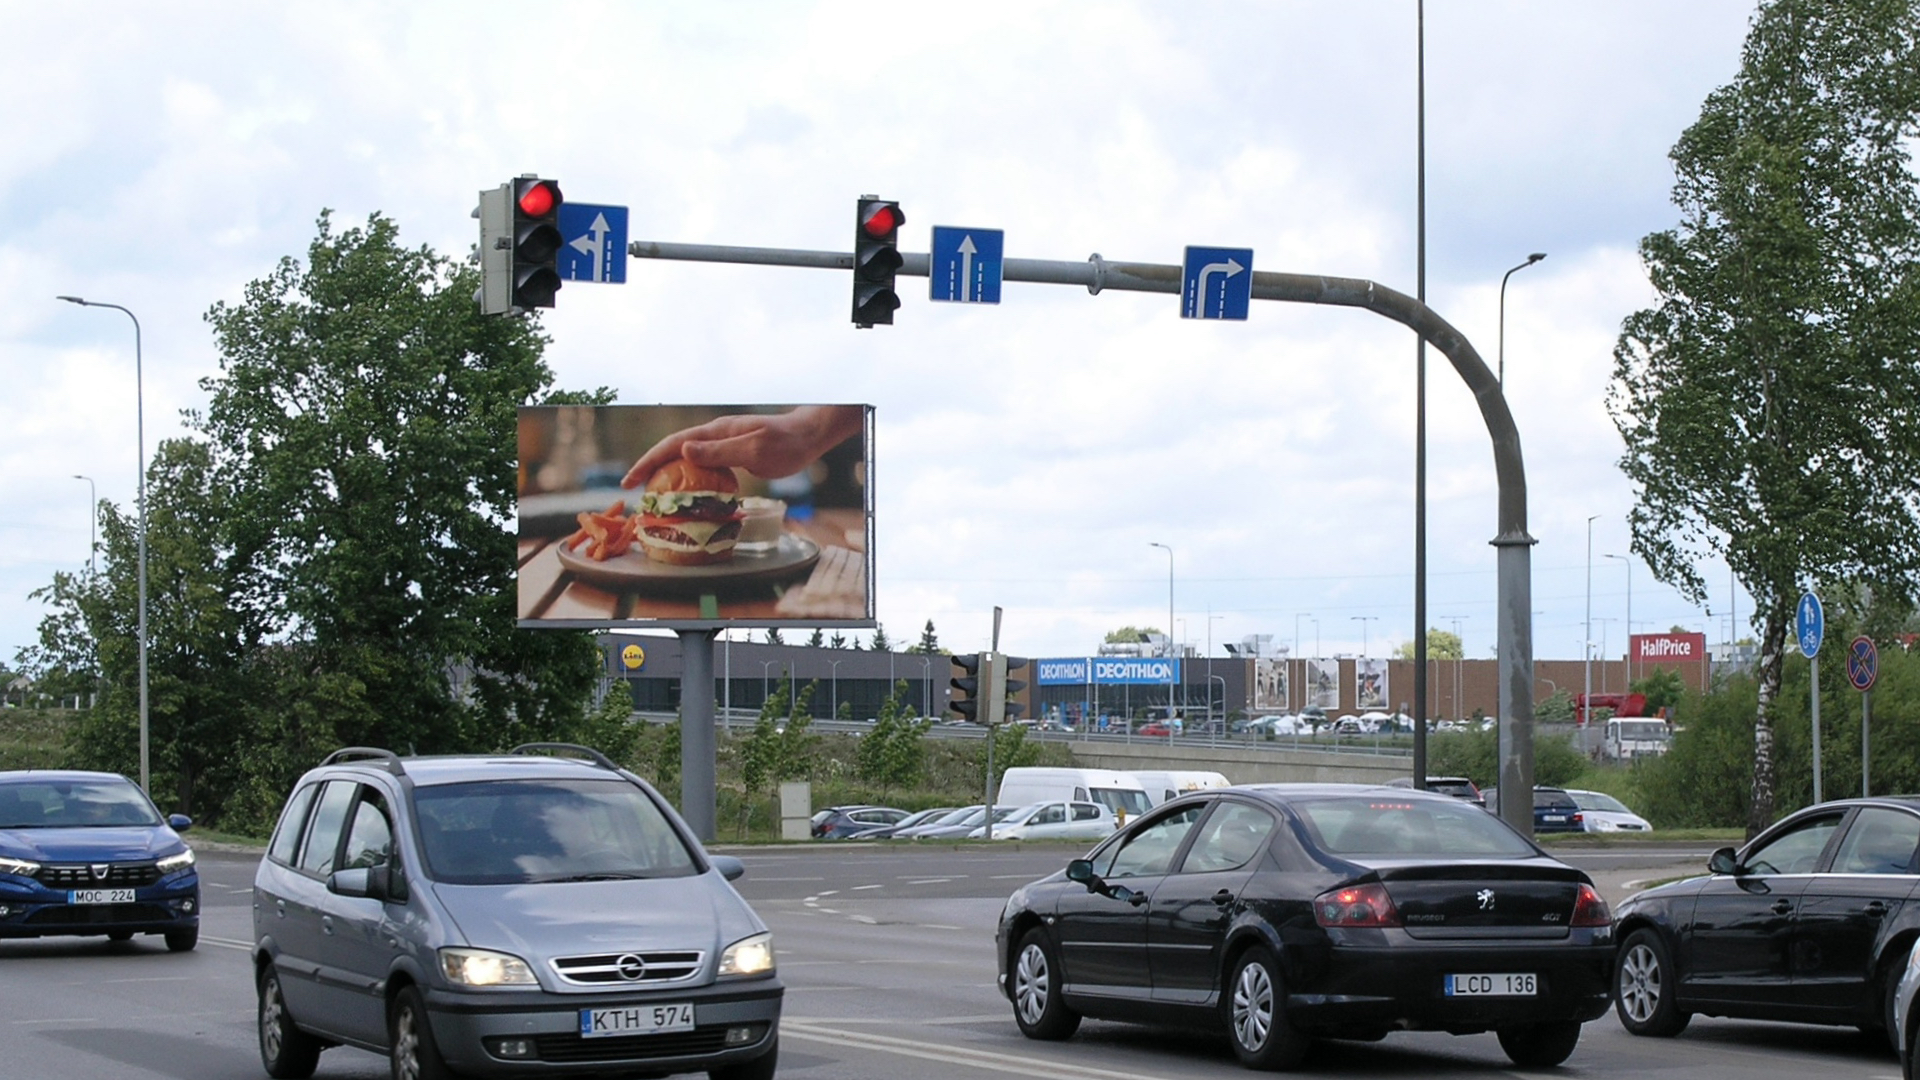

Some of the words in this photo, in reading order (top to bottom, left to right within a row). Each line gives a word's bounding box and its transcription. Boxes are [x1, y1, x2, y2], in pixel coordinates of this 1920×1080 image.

[1641, 638, 1691, 656] HalfPrice
[1040, 663, 1084, 679] DECATHLON
[1096, 663, 1172, 678] DECATHLON
[76, 891, 102, 902] MOC
[111, 890, 133, 901] 224
[1455, 976, 1492, 993] LCD
[1506, 976, 1534, 993] 136
[594, 1009, 639, 1030] KTH
[654, 1006, 690, 1026] 574
